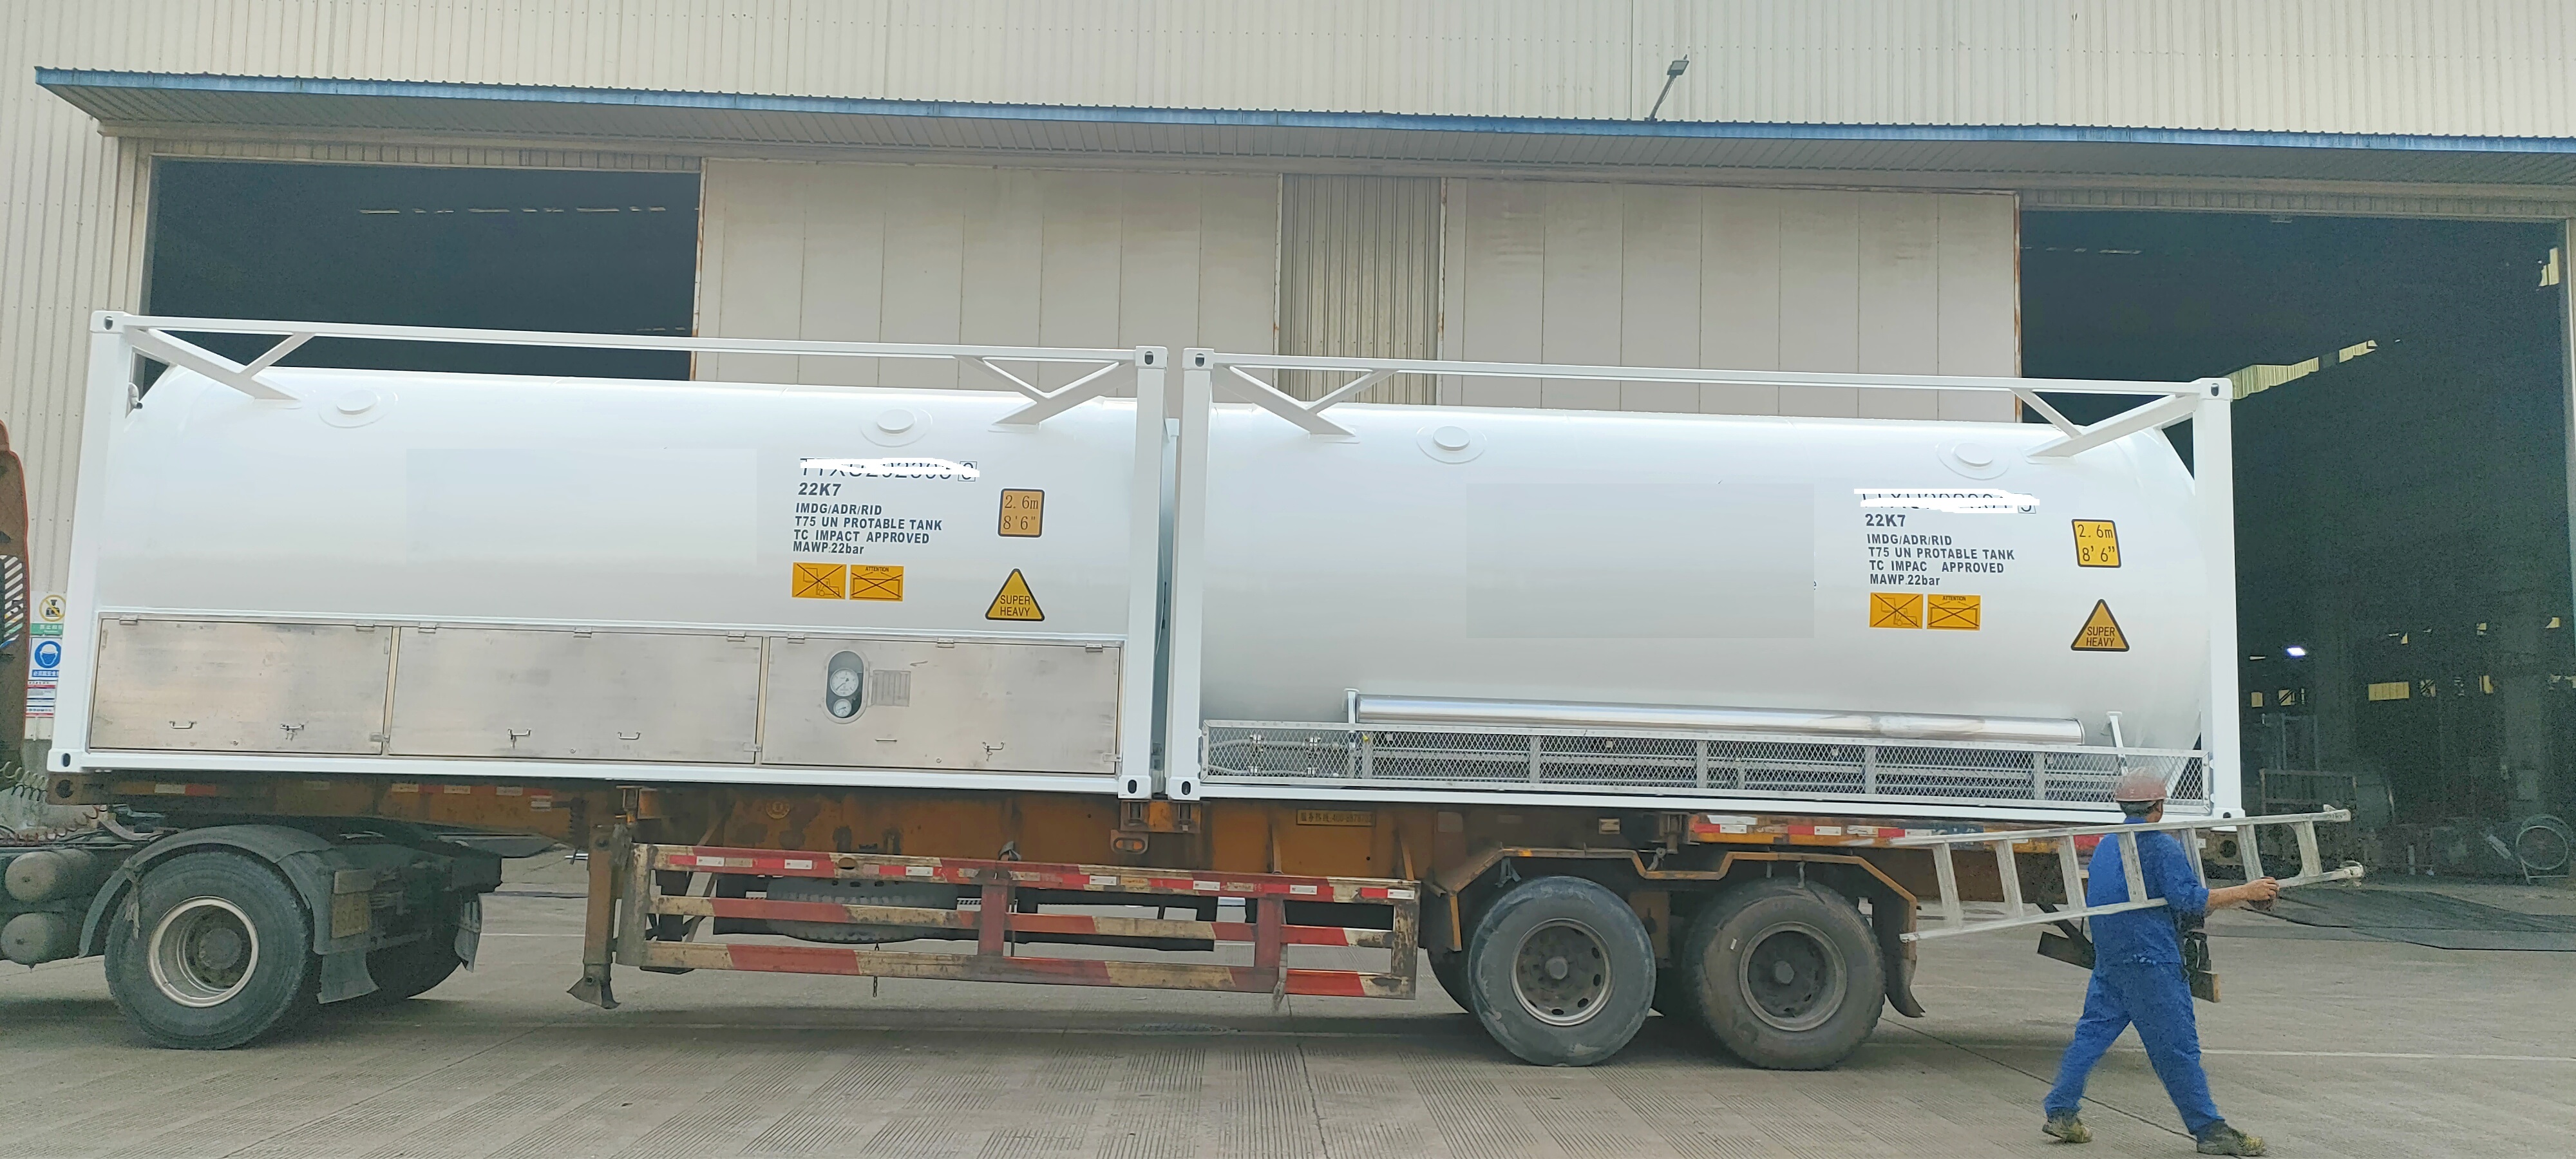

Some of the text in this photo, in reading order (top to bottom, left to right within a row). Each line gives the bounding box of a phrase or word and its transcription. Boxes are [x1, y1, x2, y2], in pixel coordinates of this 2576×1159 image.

[798, 482, 842, 496] 22K7
[796, 503, 882, 515] IMDG/ADR/RID
[795, 516, 942, 531] T75 UN PROTABLE TANK
[1866, 514, 1906, 527] 22K7
[793, 529, 929, 543] TC IMPACT APPROVED
[1867, 534, 1952, 545] IMDG/ADR/RID
[1869, 547, 2014, 560] T75 UN PROTABLE TANK
[1870, 560, 2003, 572] TC IMPAC APPROVED
[1000, 595, 1030, 605] SUPER
[1000, 607, 1030, 616] HEAVY
[2087, 627, 2115, 637] SUPER
[2086, 637, 2114, 647] HEAVY
